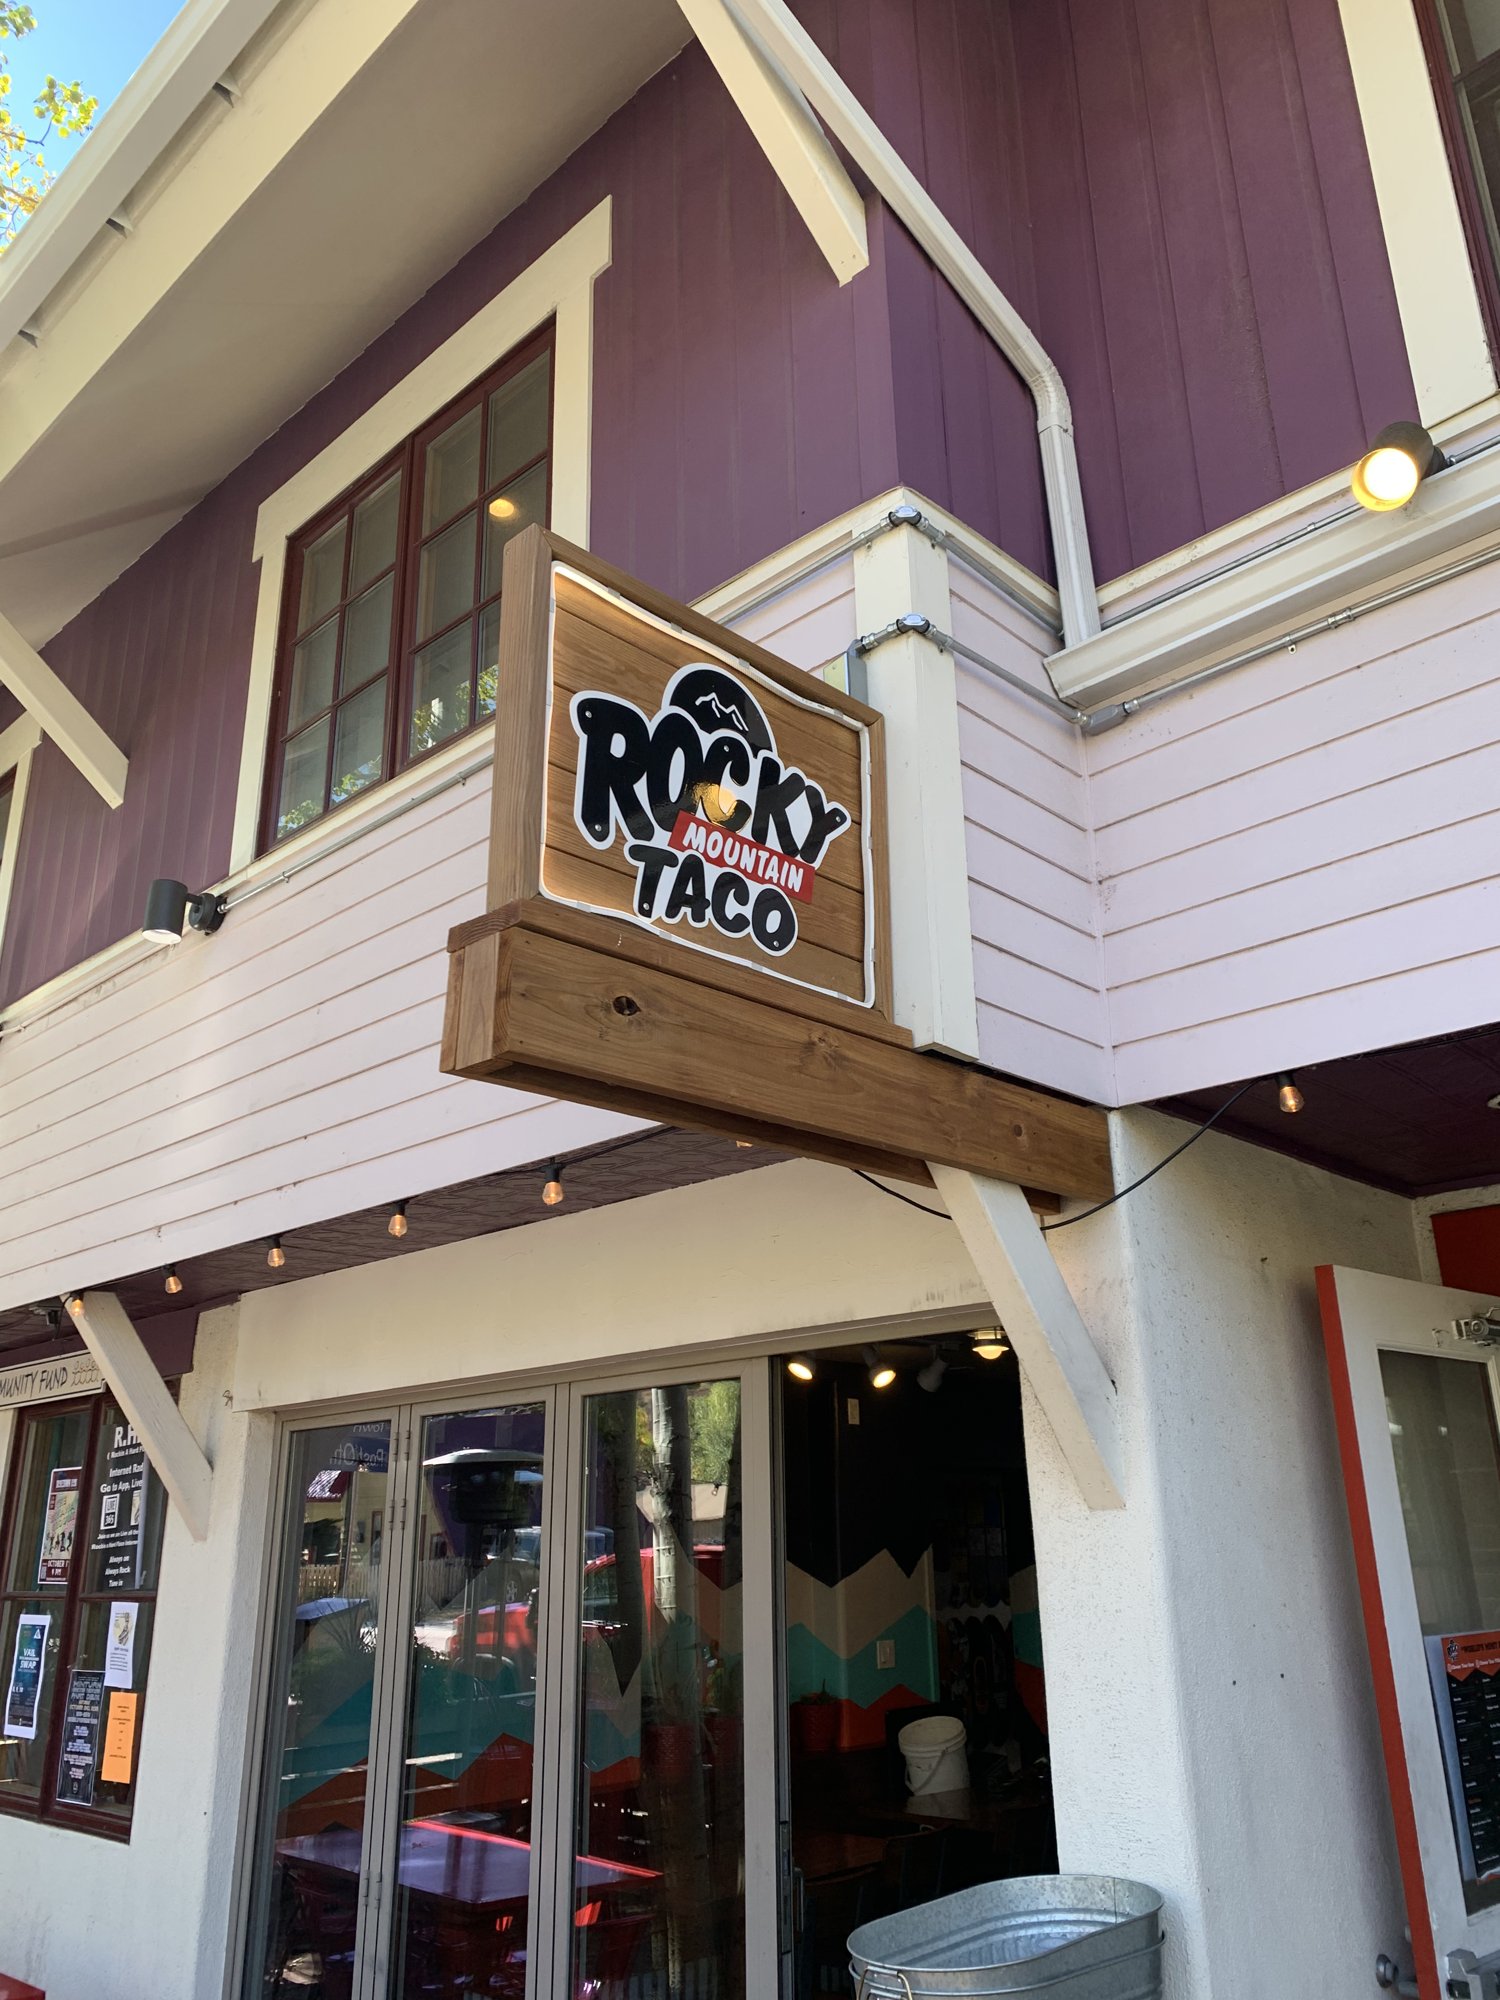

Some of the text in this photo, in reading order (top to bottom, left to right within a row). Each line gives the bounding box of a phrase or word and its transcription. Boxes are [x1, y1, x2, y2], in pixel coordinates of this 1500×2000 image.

[575, 695, 849, 866] ROCKY
[682, 821, 805, 893] MOUNTAIN
[628, 843, 797, 952] TACO
[39, 1366, 68, 1393] FUND
[100, 1484, 111, 1493] Go
